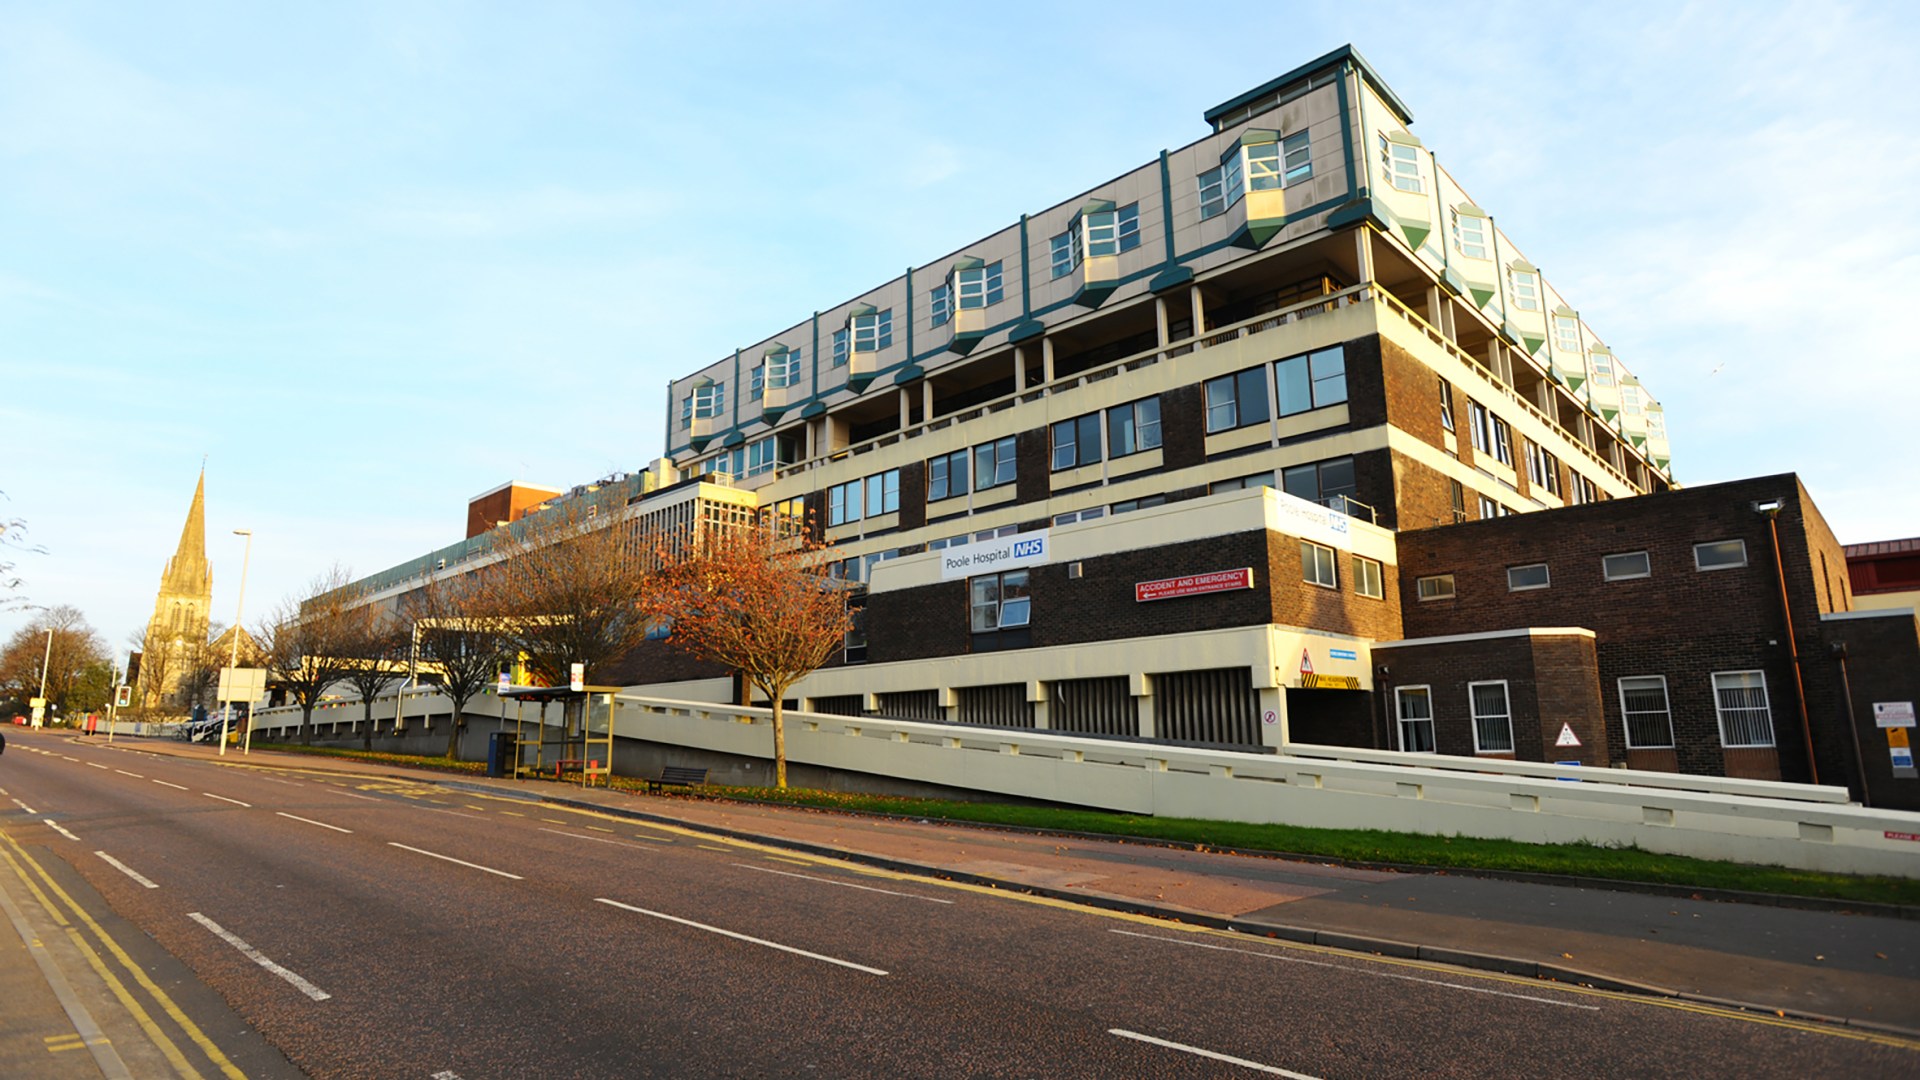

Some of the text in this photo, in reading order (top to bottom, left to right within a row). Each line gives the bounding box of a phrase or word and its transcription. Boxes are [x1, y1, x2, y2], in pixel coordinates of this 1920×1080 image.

[1329, 513, 1347, 534] NHS
[946, 539, 1043, 569] Poole Hospital NHS
[1140, 572, 1244, 592] ACCIDENT AND EMERGENCY
[1198, 583, 1224, 591] ENTRANCE
